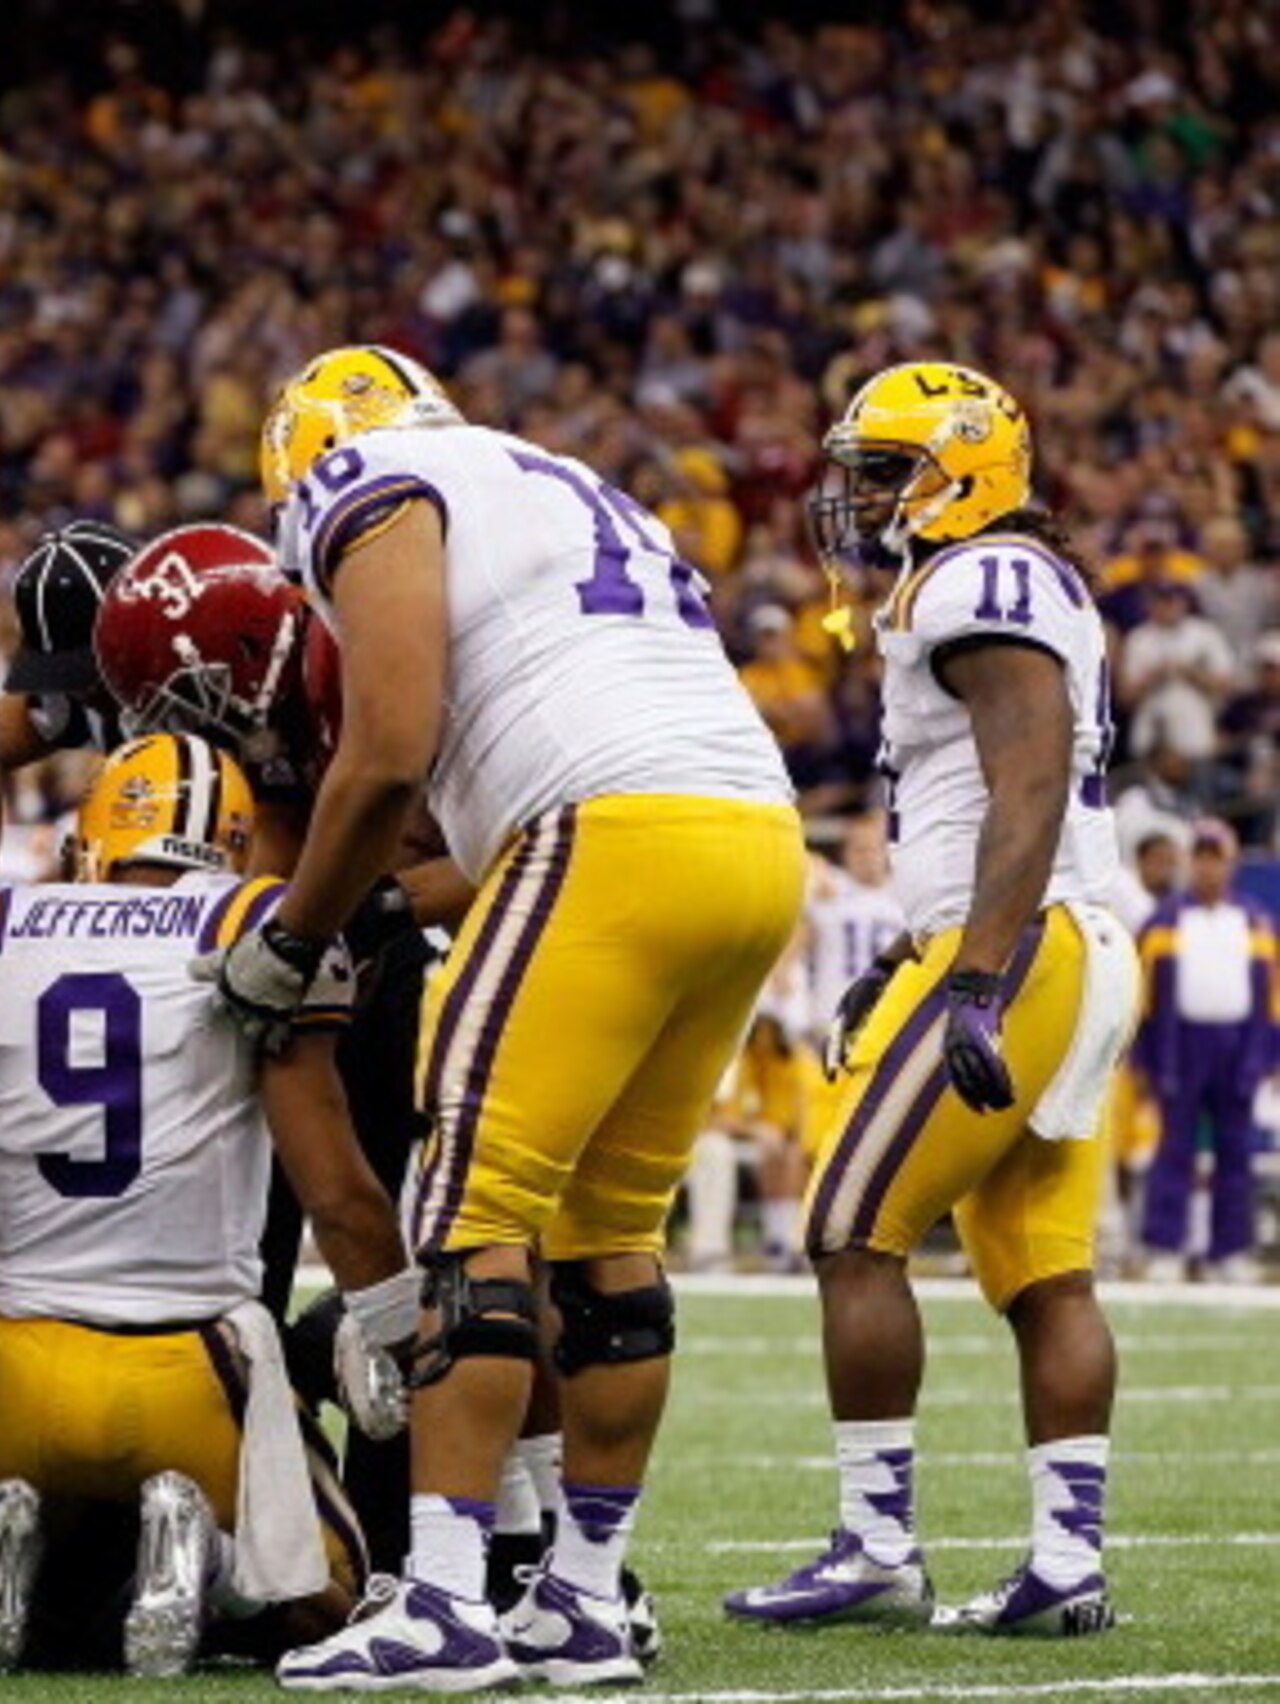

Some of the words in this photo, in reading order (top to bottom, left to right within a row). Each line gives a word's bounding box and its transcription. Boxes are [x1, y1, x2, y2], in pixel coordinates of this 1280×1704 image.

[140, 551, 206, 620] 37
[973, 556, 1033, 625] 11
[10, 895, 205, 938] JEFFERSON
[37, 972, 143, 1199] 9
